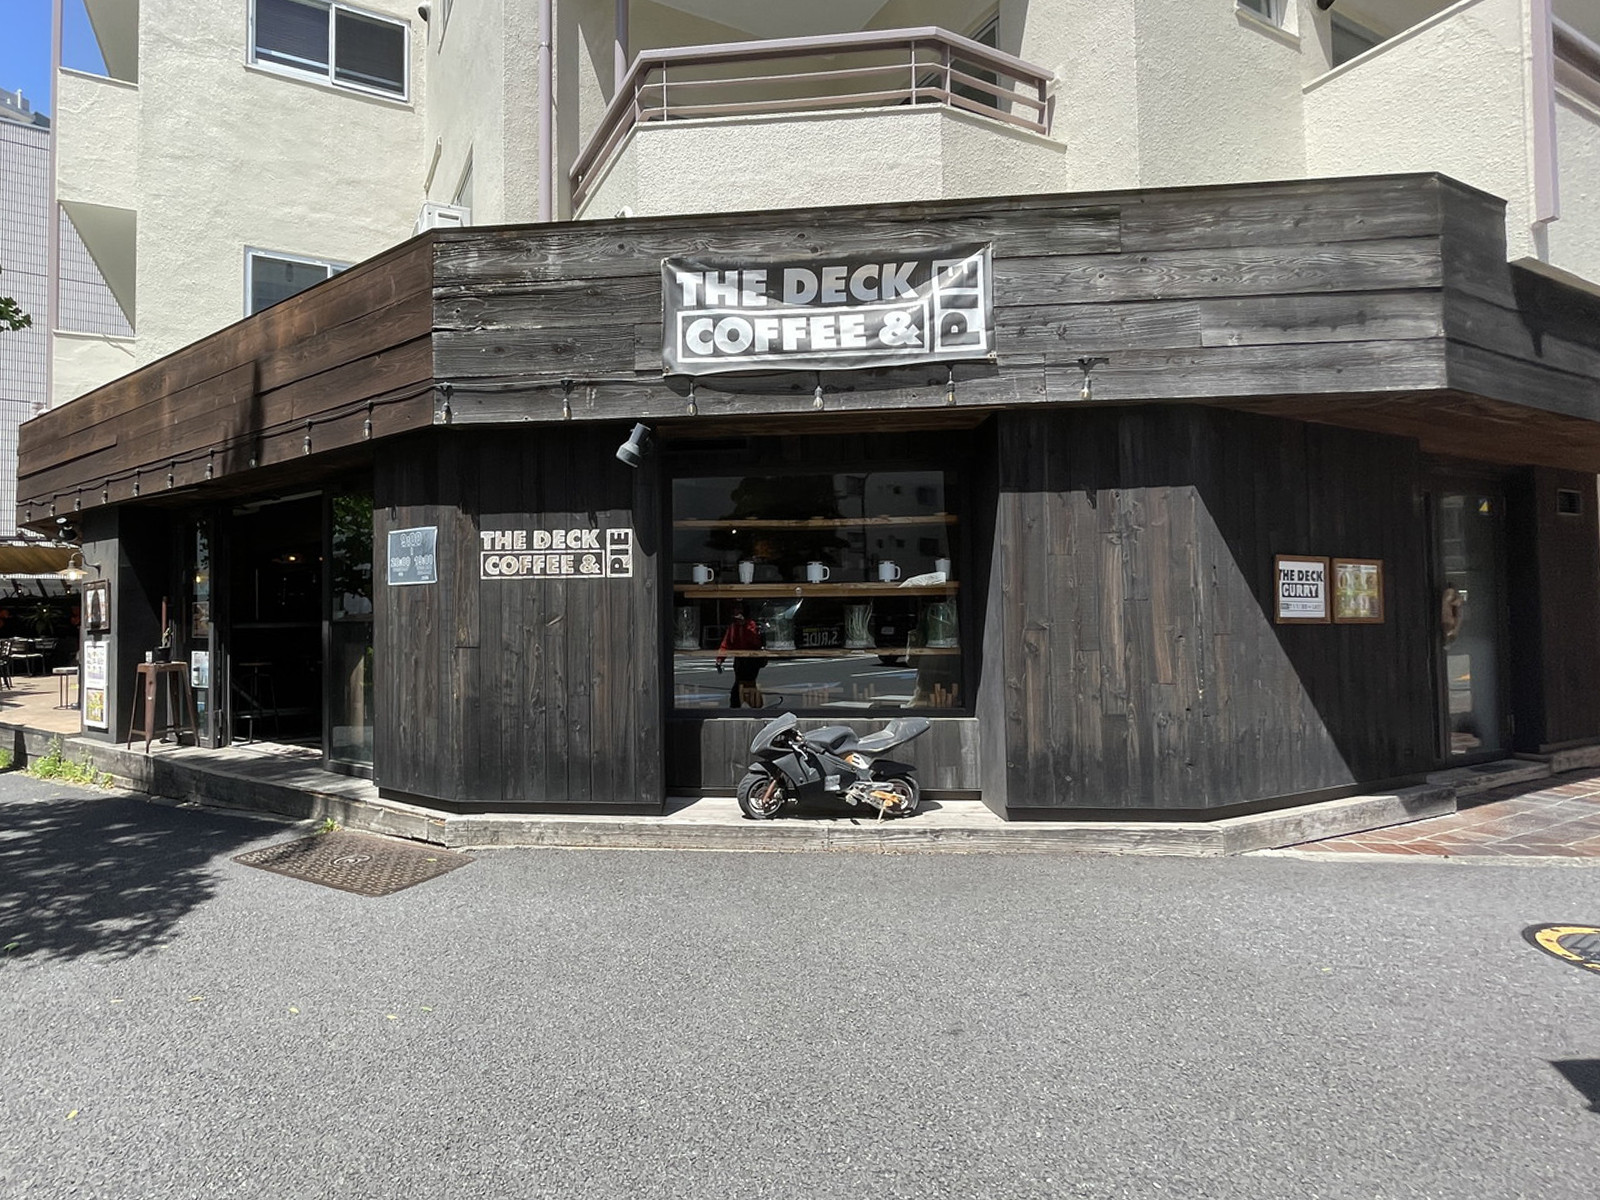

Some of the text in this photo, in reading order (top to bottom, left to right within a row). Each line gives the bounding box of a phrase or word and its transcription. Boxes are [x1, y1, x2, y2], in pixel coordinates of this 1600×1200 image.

[676, 261, 919, 307] THE DECK
[939, 260, 981, 348] PIE
[686, 310, 923, 355] COFFEE &
[480, 529, 601, 550] THE DECK
[609, 530, 630, 574] PIE
[484, 555, 601, 576] COFFEE &
[1279, 569, 1295, 581] THE
[1297, 569, 1323, 582] DECK
[1282, 583, 1317, 597] CURRY
